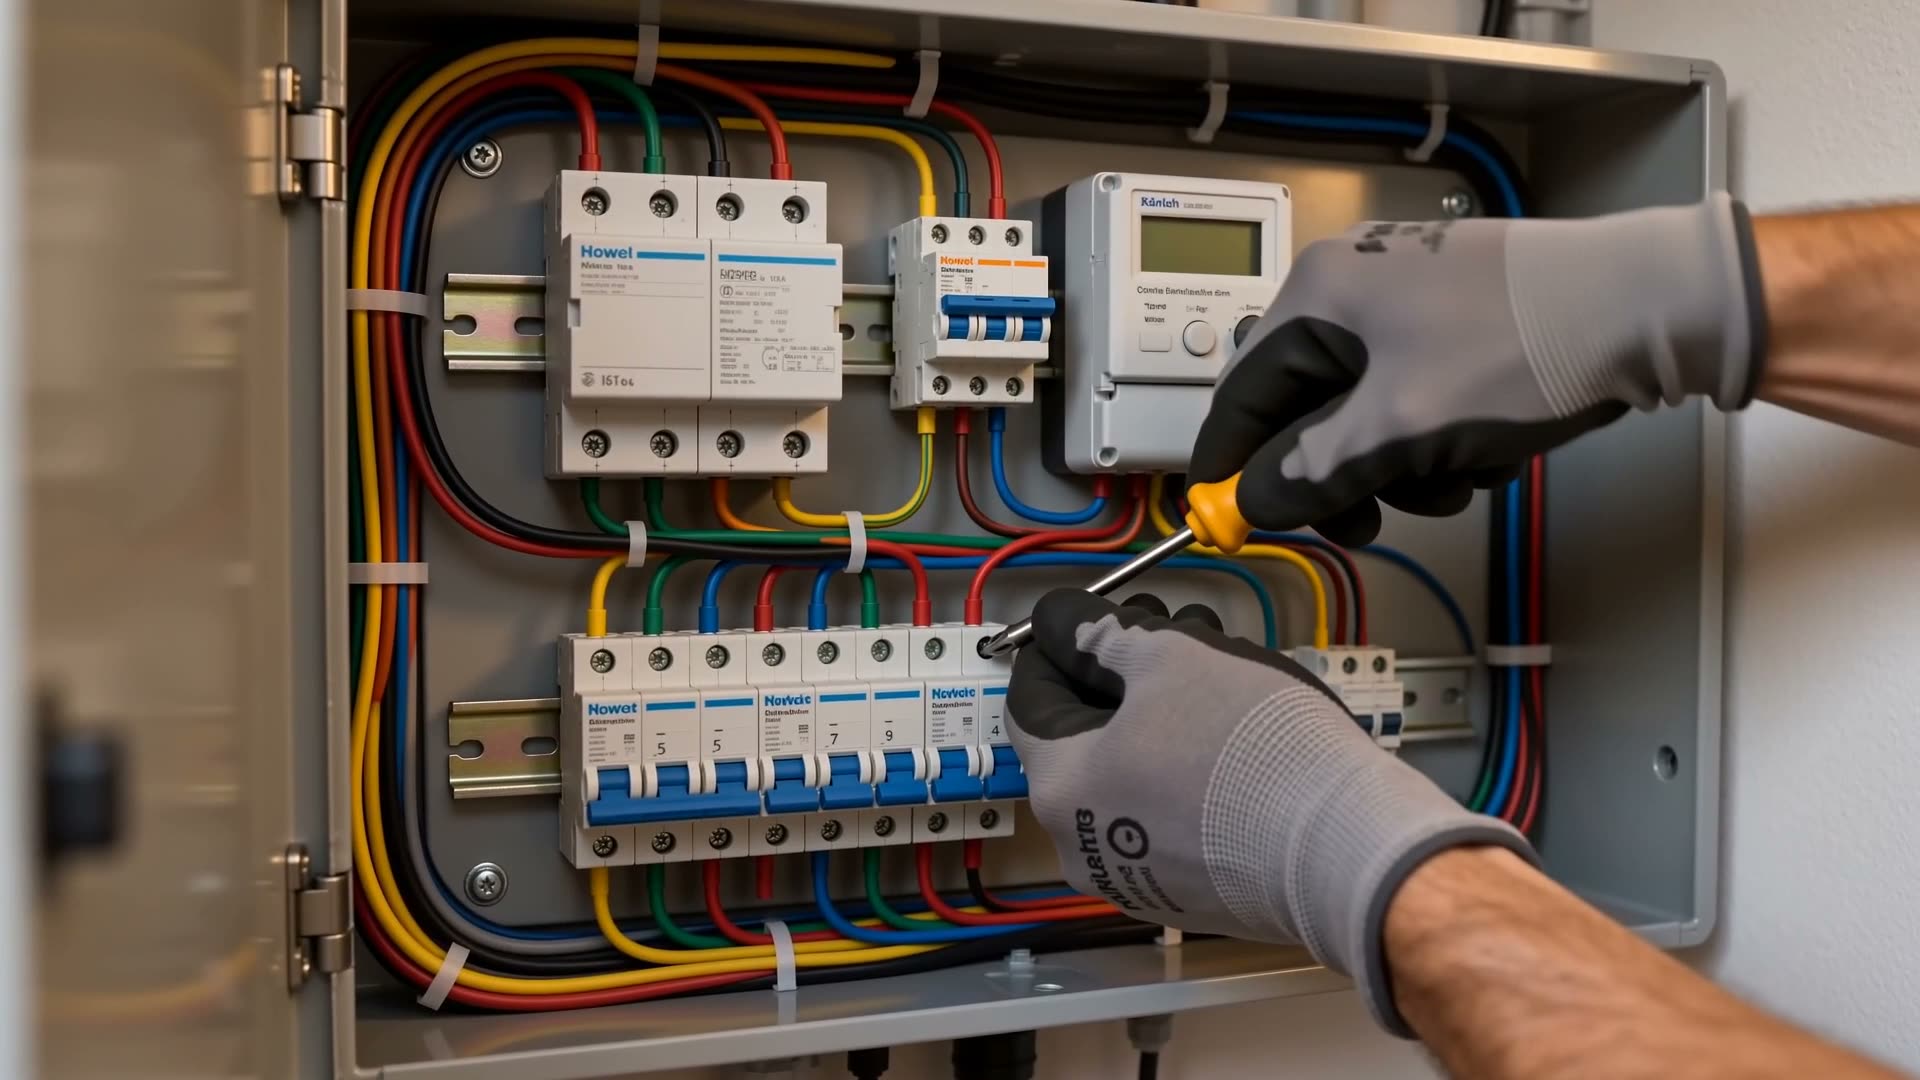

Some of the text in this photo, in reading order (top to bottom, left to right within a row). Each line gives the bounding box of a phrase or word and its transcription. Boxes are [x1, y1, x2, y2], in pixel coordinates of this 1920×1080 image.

[580, 245, 633, 259] Howel
[885, 730, 893, 741] 9
[991, 725, 1000, 737] 4
[830, 733, 839, 745] 7
[657, 742, 666, 755] 5
[713, 739, 721, 752] 5
